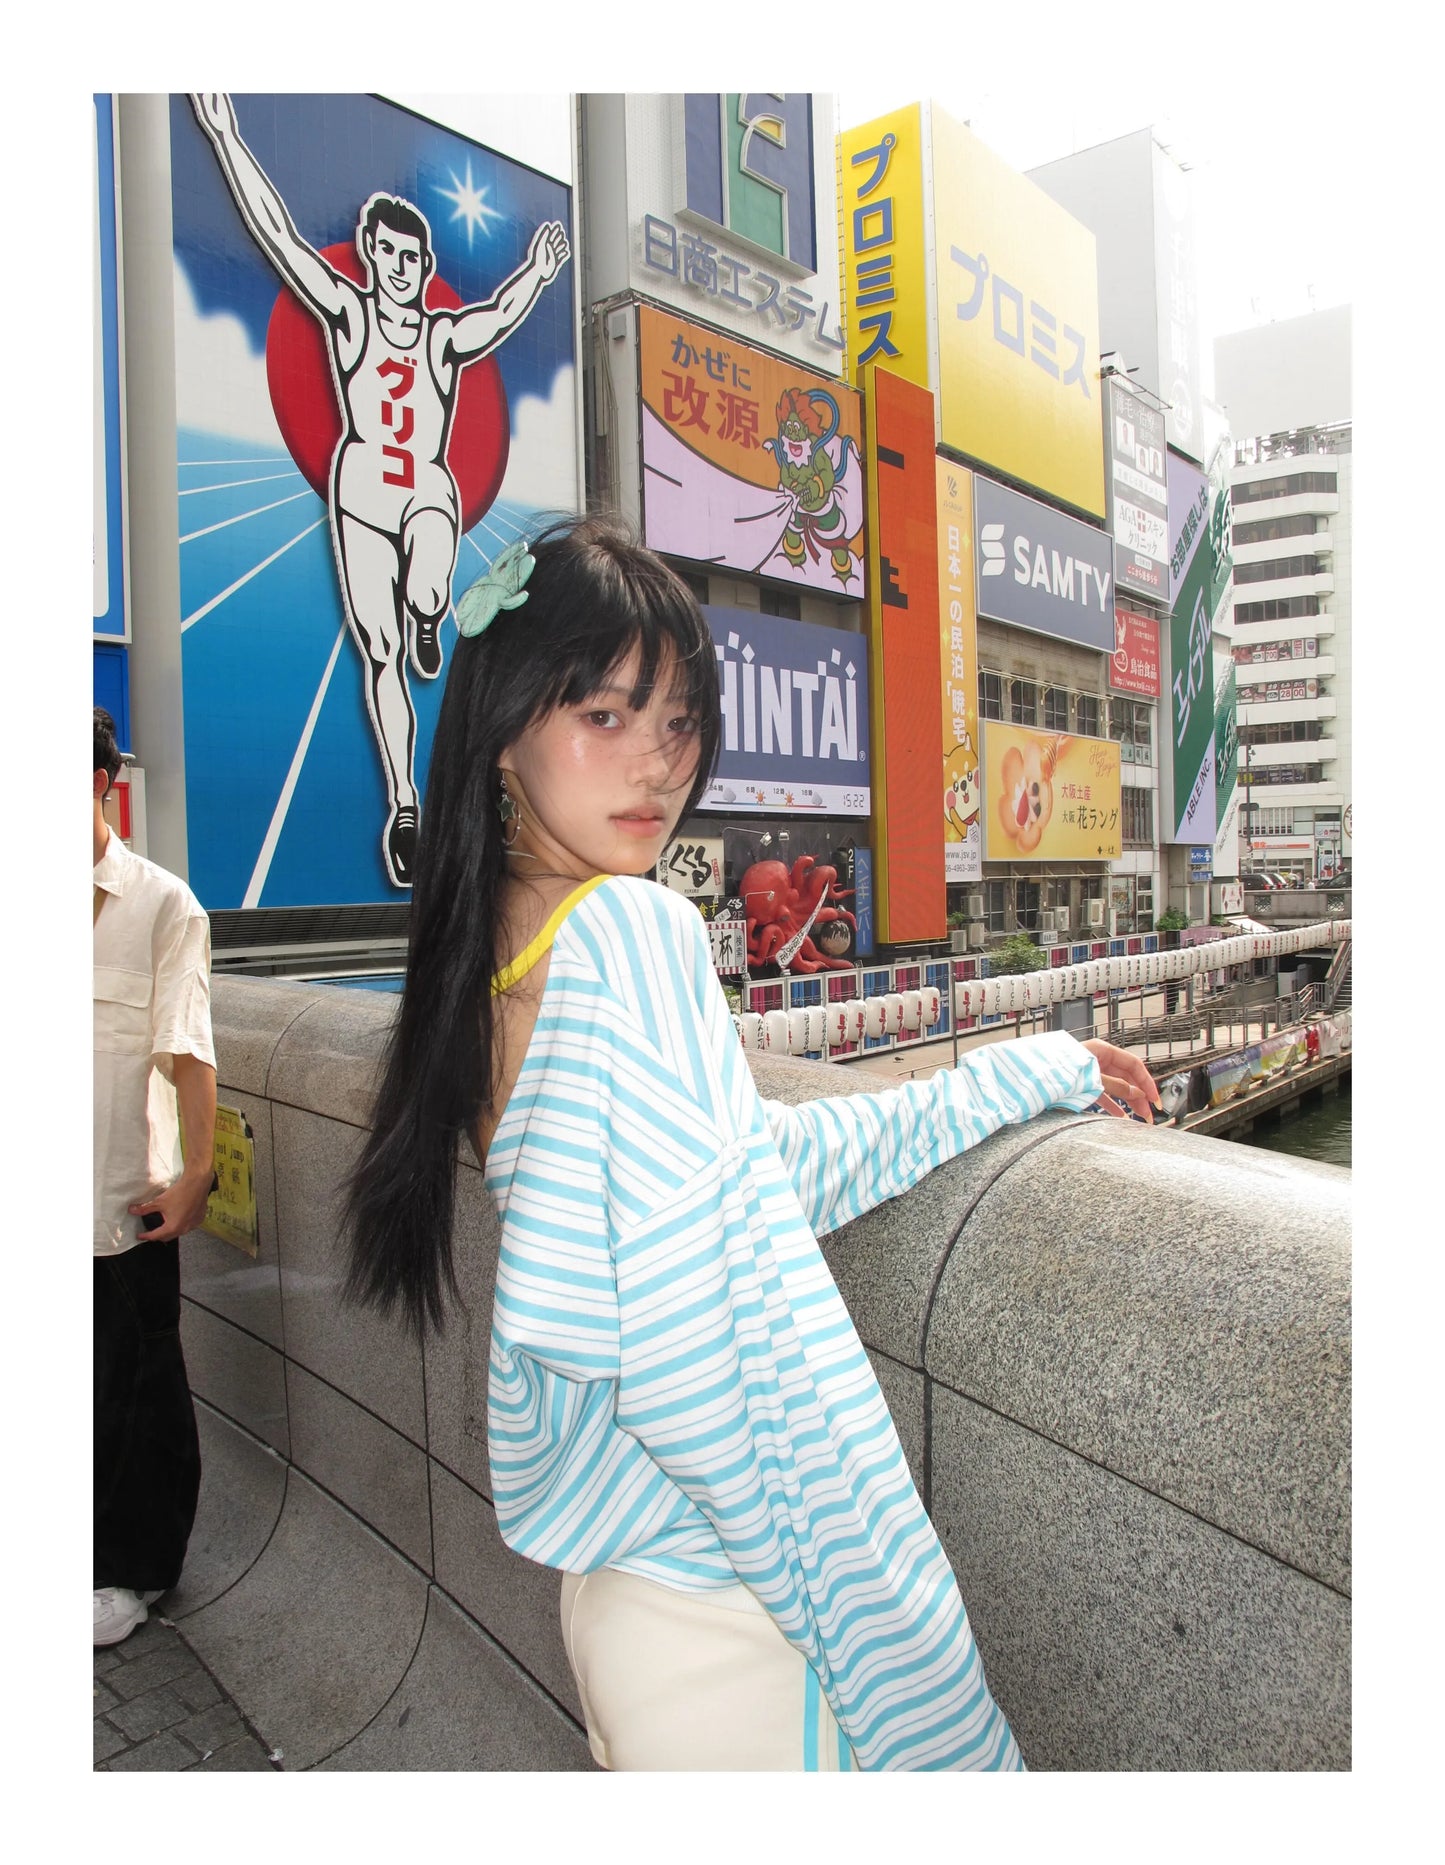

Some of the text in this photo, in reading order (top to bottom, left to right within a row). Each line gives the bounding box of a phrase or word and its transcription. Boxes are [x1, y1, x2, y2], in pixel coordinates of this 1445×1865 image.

[643, 212, 846, 351] 日商エステム
[851, 132, 903, 366] プロミス
[670, 333, 752, 392] かぜに
[950, 244, 1092, 399] プロミス
[376, 356, 418, 490] グリコ
[661, 369, 762, 450] 改源
[1013, 535, 1111, 613] SAMTY
[669, 843, 712, 888] くくる
